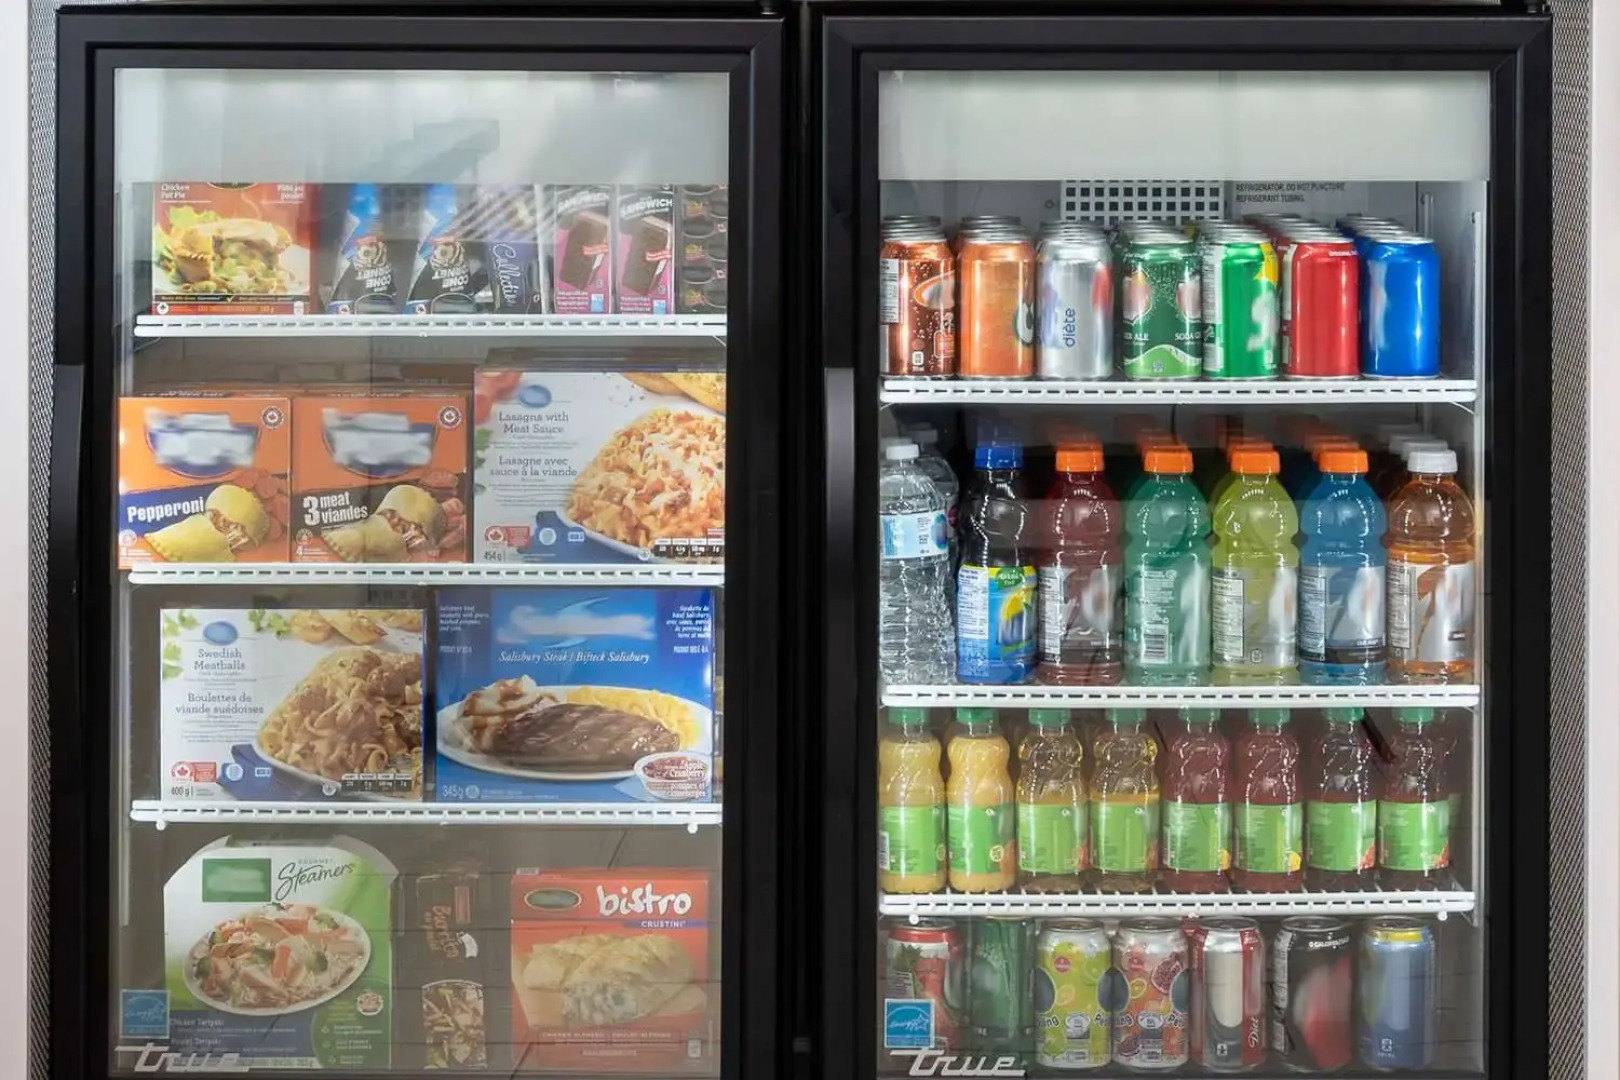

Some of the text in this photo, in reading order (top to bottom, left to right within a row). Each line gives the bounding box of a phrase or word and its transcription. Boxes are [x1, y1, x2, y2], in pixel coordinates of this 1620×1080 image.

[620, 197, 673, 218] SANDWICH
[442, 274, 469, 289] CONE
[1064, 307, 1077, 348] diète
[498, 411, 570, 424] Lasagna with
[503, 424, 565, 434] Meat Sauce
[498, 456, 569, 468] Lasagne avec
[489, 468, 519, 477] sauce
[530, 466, 540, 476] la
[541, 466, 578, 476] viande
[127, 496, 205, 523] Pepperoni
[303, 492, 350, 527] 3 meat
[321, 507, 368, 524] viandes
[198, 648, 243, 660] Swedish
[498, 651, 541, 664] Salisbury
[543, 651, 569, 662] Steak
[576, 651, 606, 665] Bifteck
[607, 651, 650, 665] Salisbury
[194, 660, 246, 671] Meatballs
[187, 692, 252, 703] Boulettes de
[175, 702, 264, 715] viande suédoises
[274, 862, 356, 902] Steamers
[596, 884, 693, 917] bistro
[641, 920, 685, 929] CRUSTINI
[1248, 1016, 1260, 1048] Diet
